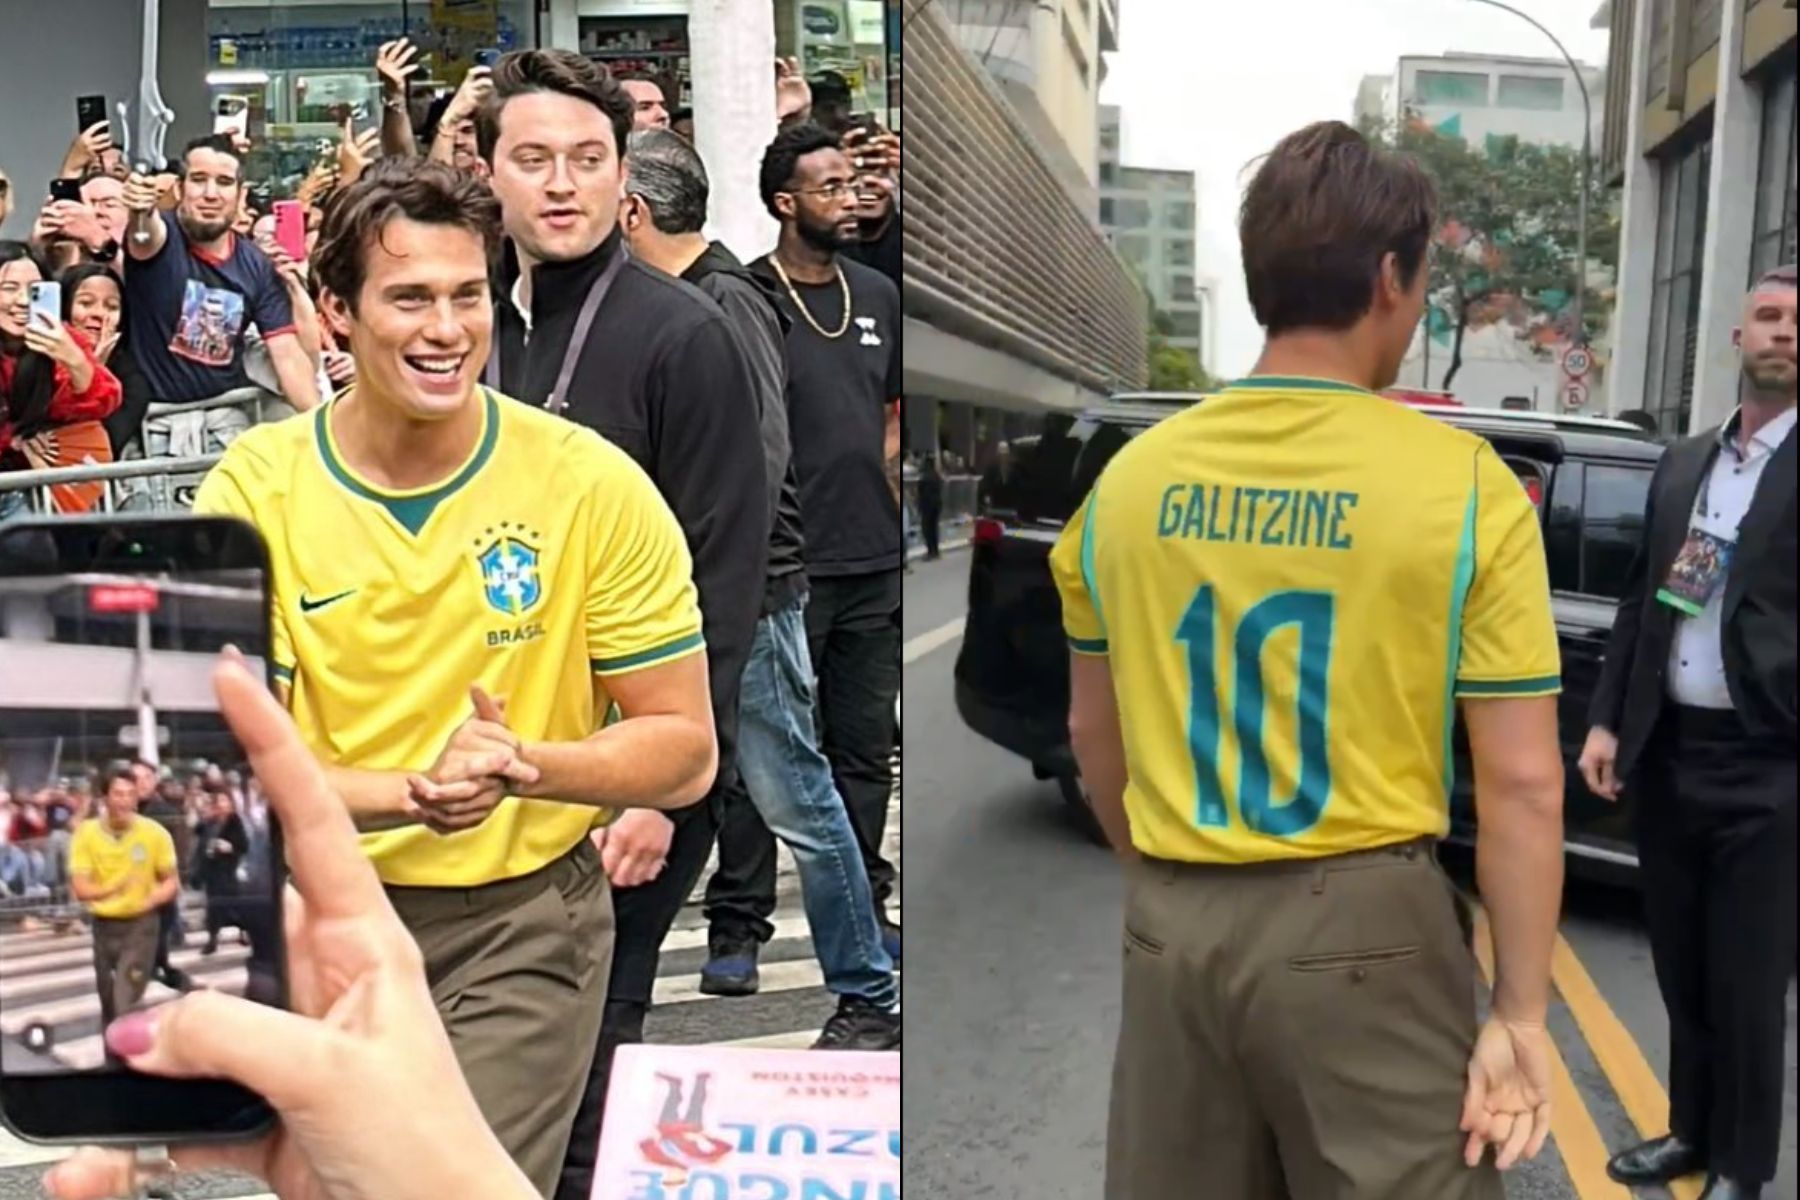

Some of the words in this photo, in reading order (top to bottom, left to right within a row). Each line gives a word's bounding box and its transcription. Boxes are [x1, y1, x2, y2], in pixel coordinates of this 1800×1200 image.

[1568, 354, 1586, 369] 50
[1158, 482, 1359, 550] GALITZINE
[486, 621, 546, 647] BRASIL
[1173, 581, 1335, 837] 10
[718, 1122, 900, 1158] ZUL
